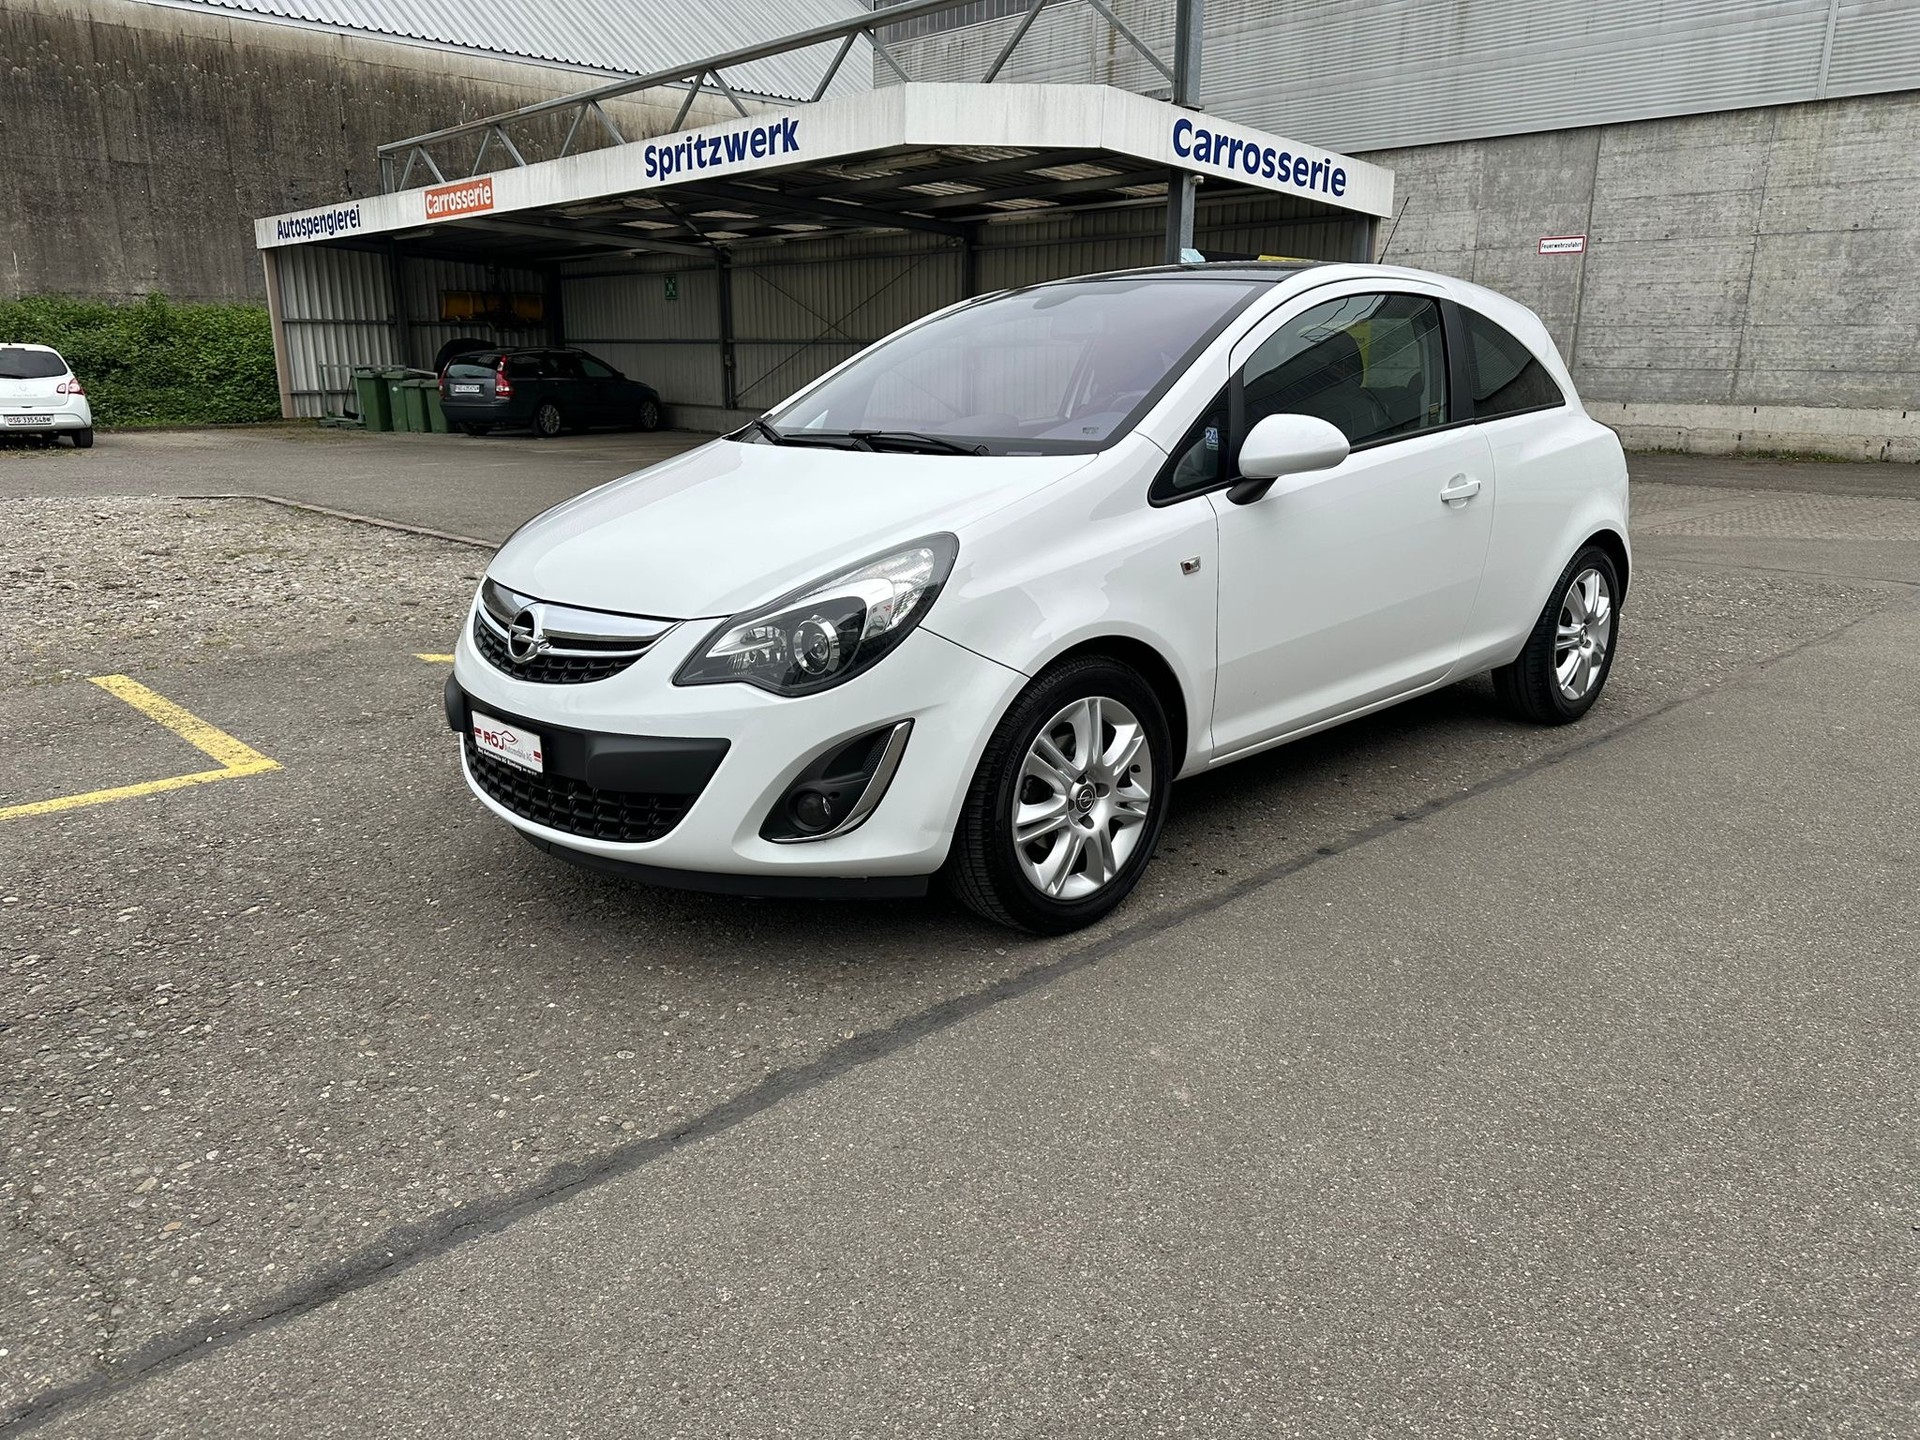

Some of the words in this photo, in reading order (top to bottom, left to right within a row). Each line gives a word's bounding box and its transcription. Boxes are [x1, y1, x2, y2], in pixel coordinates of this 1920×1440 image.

[644, 117, 800, 181] Spritzwerk
[1173, 118, 1347, 197] Carrosserie
[426, 183, 492, 214] Carrosserie
[277, 204, 361, 240] Autospenglerei
[483, 730, 505, 750] ROJ
